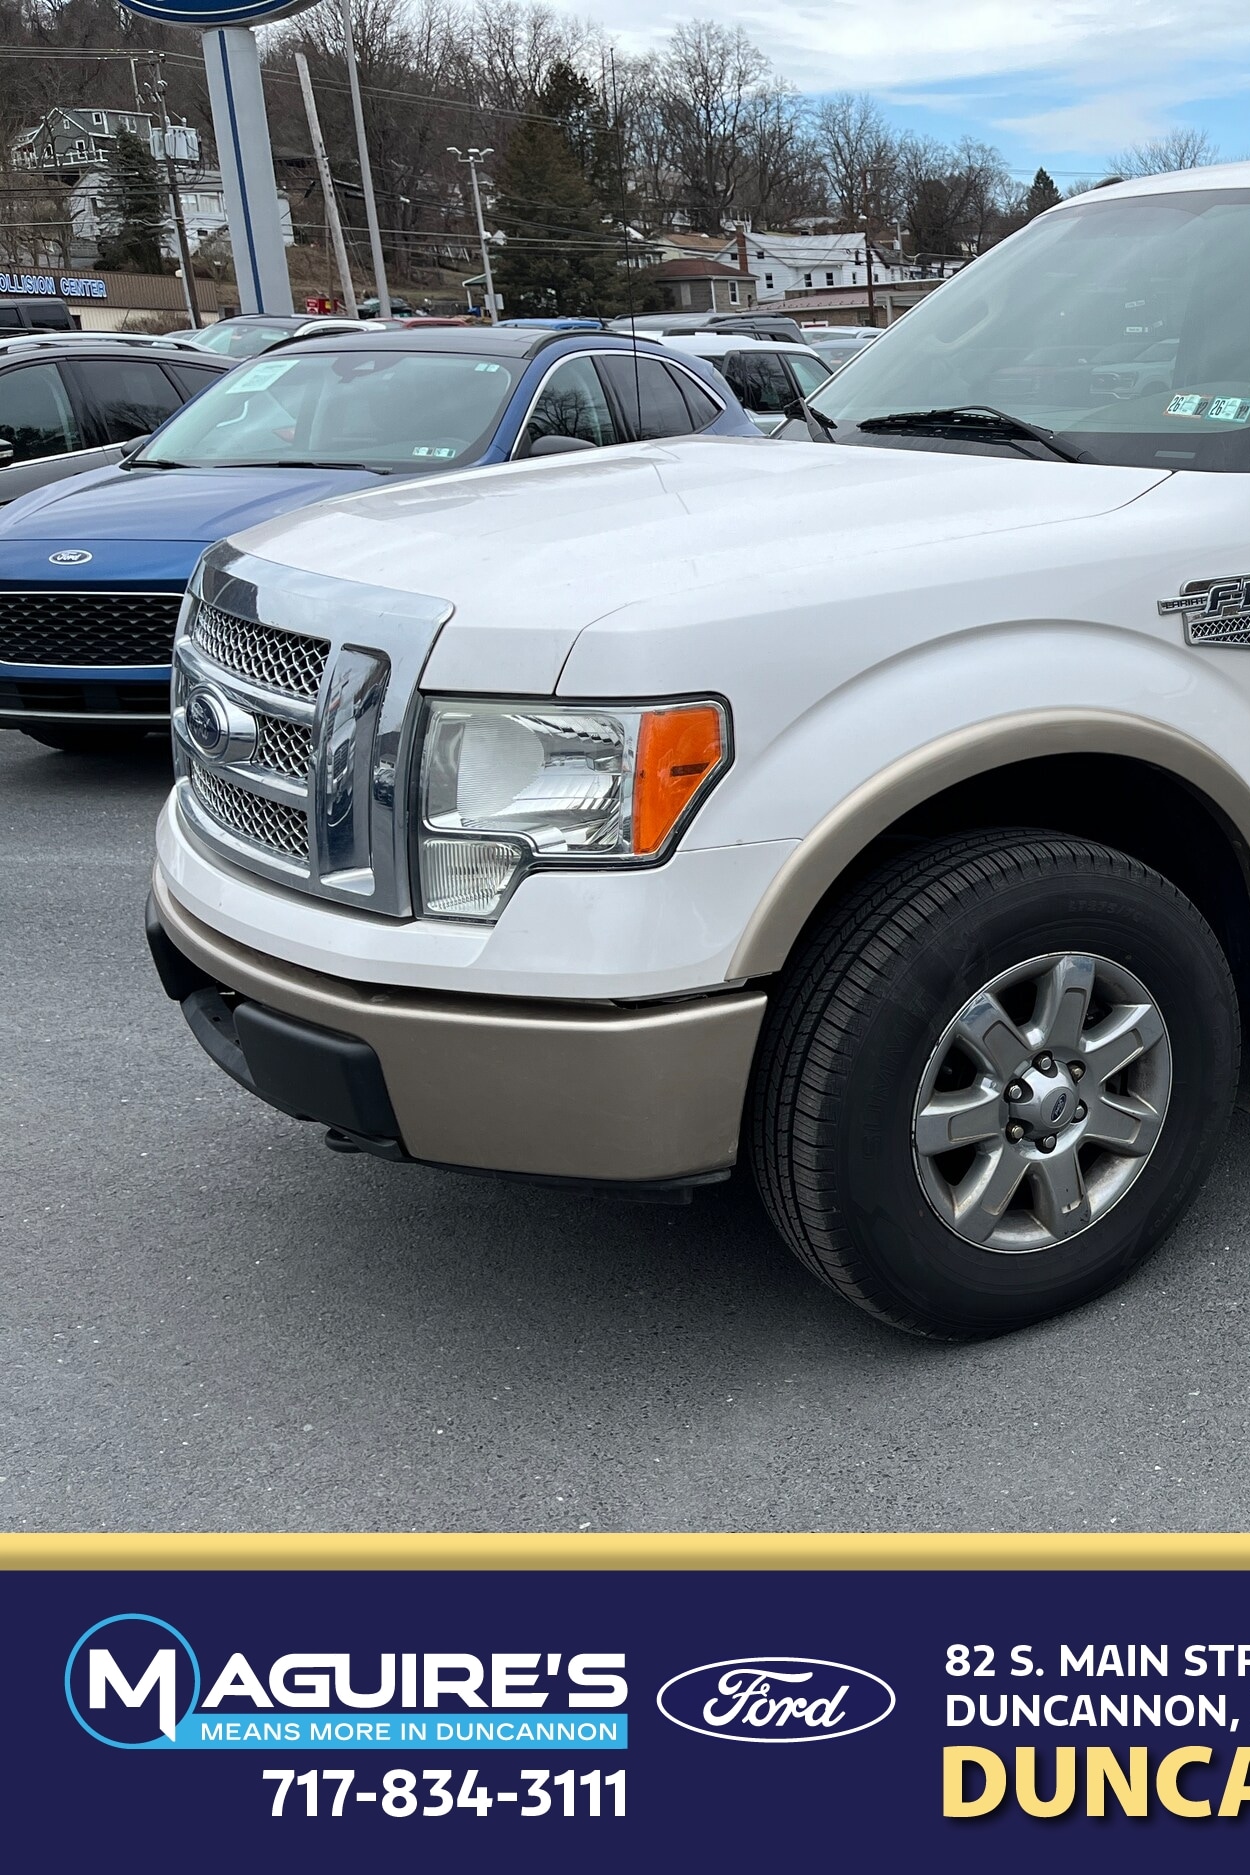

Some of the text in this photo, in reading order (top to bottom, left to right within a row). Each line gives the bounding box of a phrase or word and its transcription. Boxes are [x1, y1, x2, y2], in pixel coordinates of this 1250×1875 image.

[60, 277, 107, 297] CENTER
[1168, 396, 1184, 412] 26
[1209, 400, 1226, 415] 26
[1161, 597, 1208, 609] LARIAT
